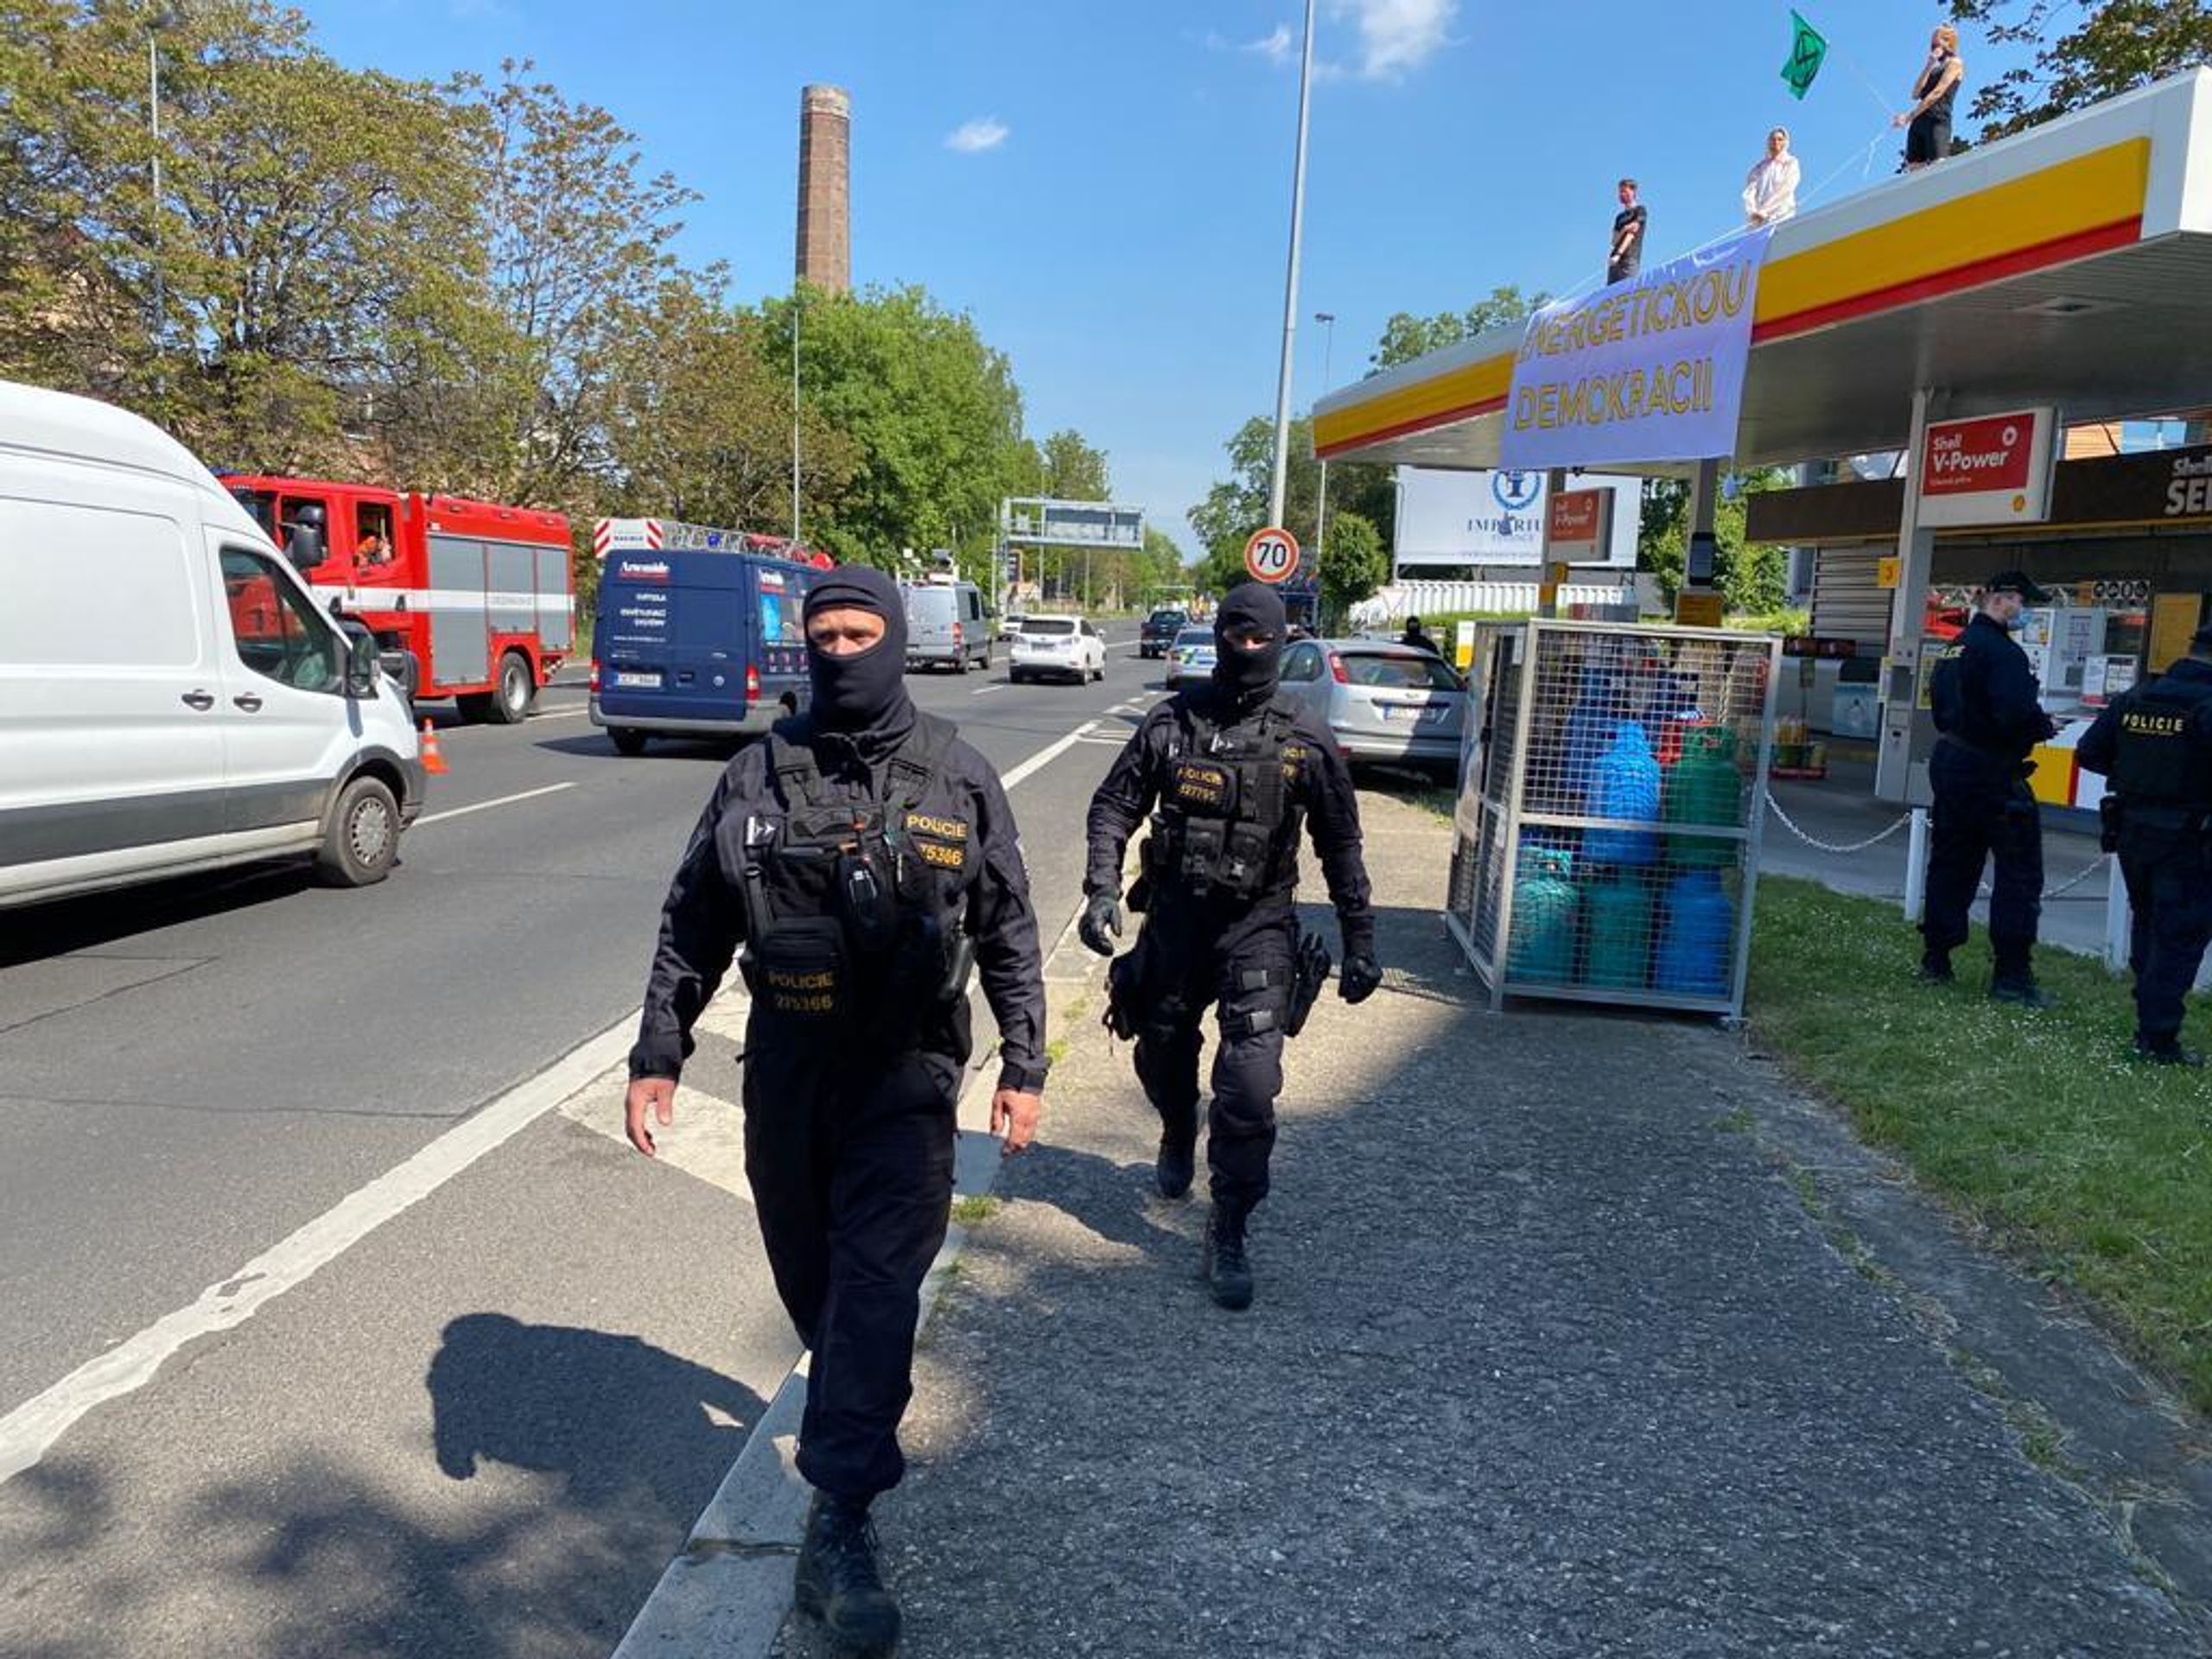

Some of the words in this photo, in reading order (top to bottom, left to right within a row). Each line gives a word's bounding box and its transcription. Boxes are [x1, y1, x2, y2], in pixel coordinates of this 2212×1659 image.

[1515, 357, 1713, 430] DEMOKRACII
[1933, 433, 1963, 450] Shell
[1933, 450, 2009, 473] V-Power
[1257, 542, 1287, 567] 70
[2122, 713, 2183, 732] POLICIE
[907, 814, 967, 837] POLICIE
[768, 969, 834, 988] POLICIE
